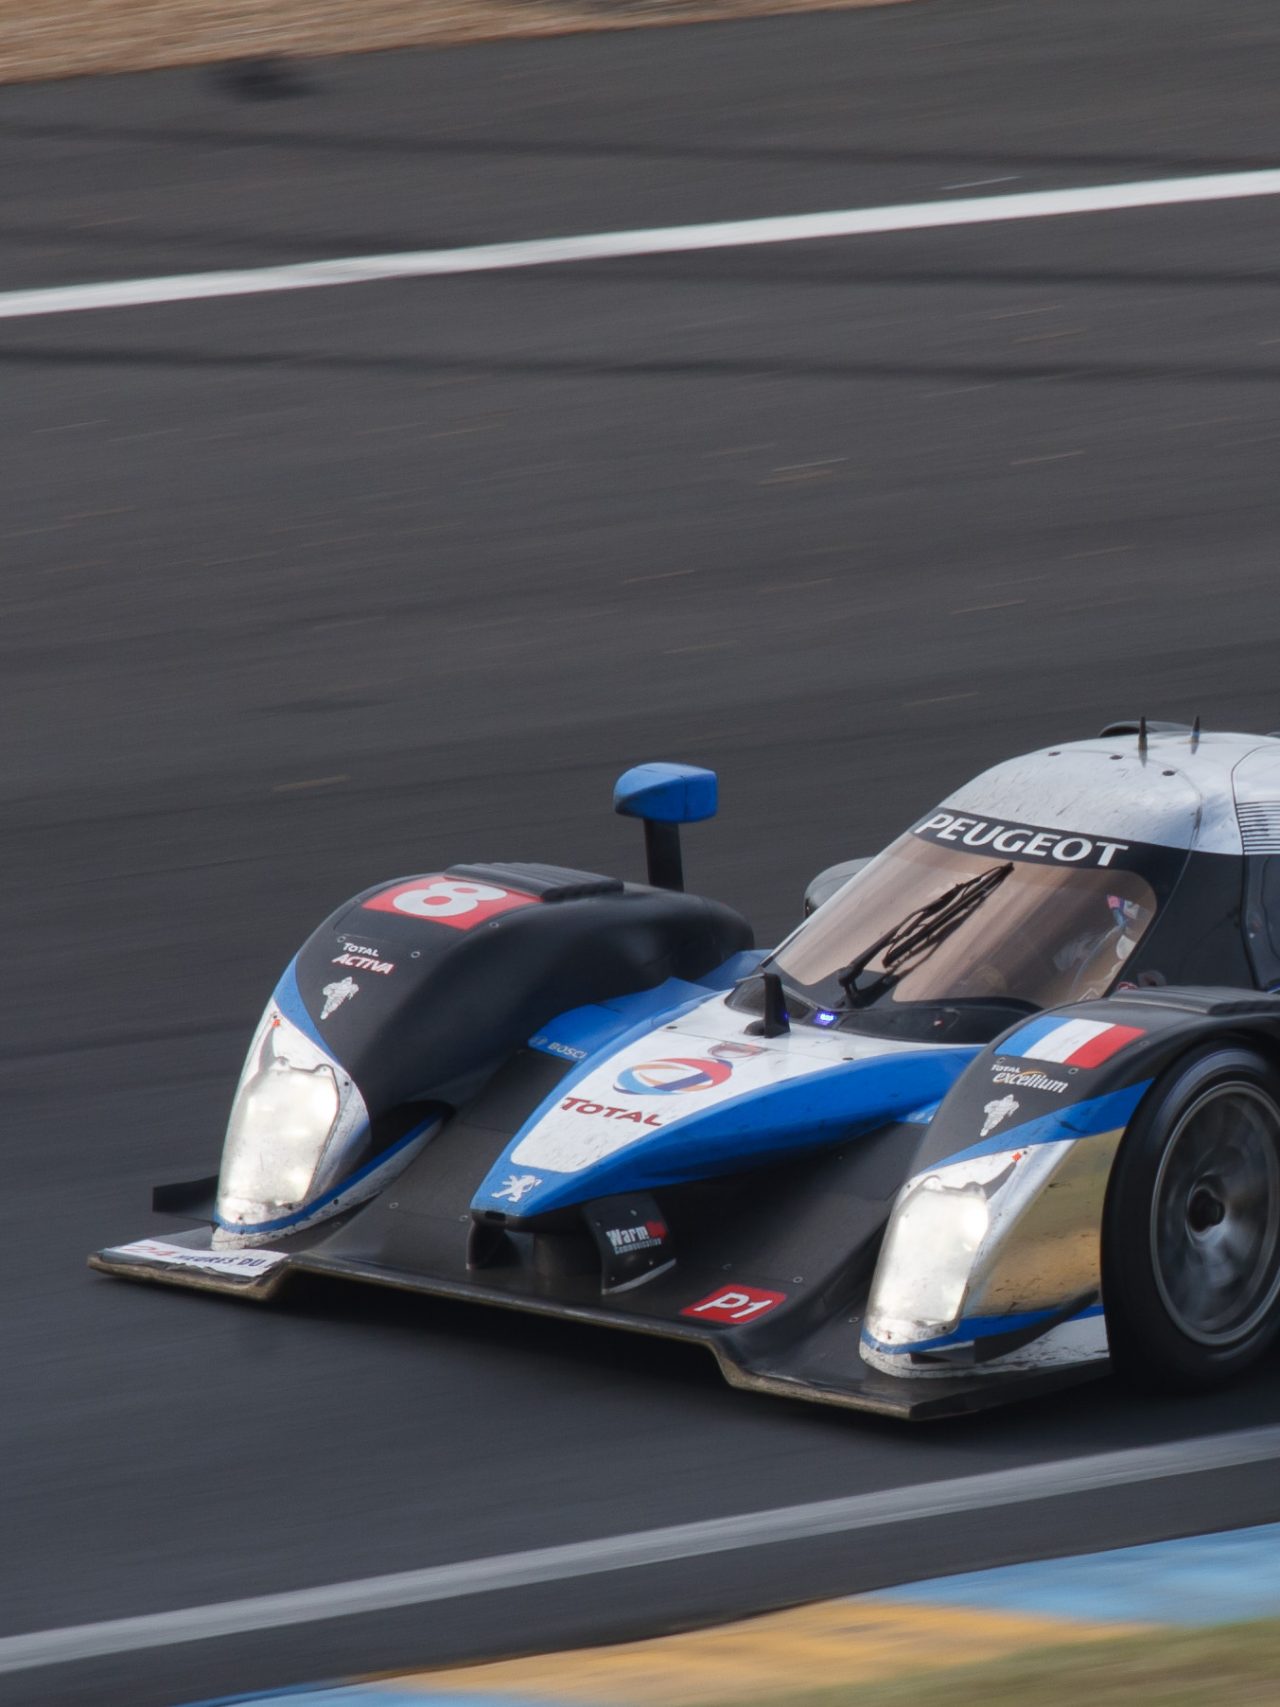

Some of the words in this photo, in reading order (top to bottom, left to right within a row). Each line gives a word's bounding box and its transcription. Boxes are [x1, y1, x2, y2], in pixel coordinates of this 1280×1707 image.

[914, 813, 1129, 867] PEUGEOT
[392, 881, 508, 917] 8
[342, 942, 380, 957] TOTAL
[332, 954, 395, 975] ACTIVA
[990, 1064, 1022, 1074] TOTAL
[993, 1072, 1069, 1093] excellium
[561, 1096, 663, 1127] TOTAL
[237, 1257, 267, 1268] DU
[693, 1292, 773, 1320] P1
